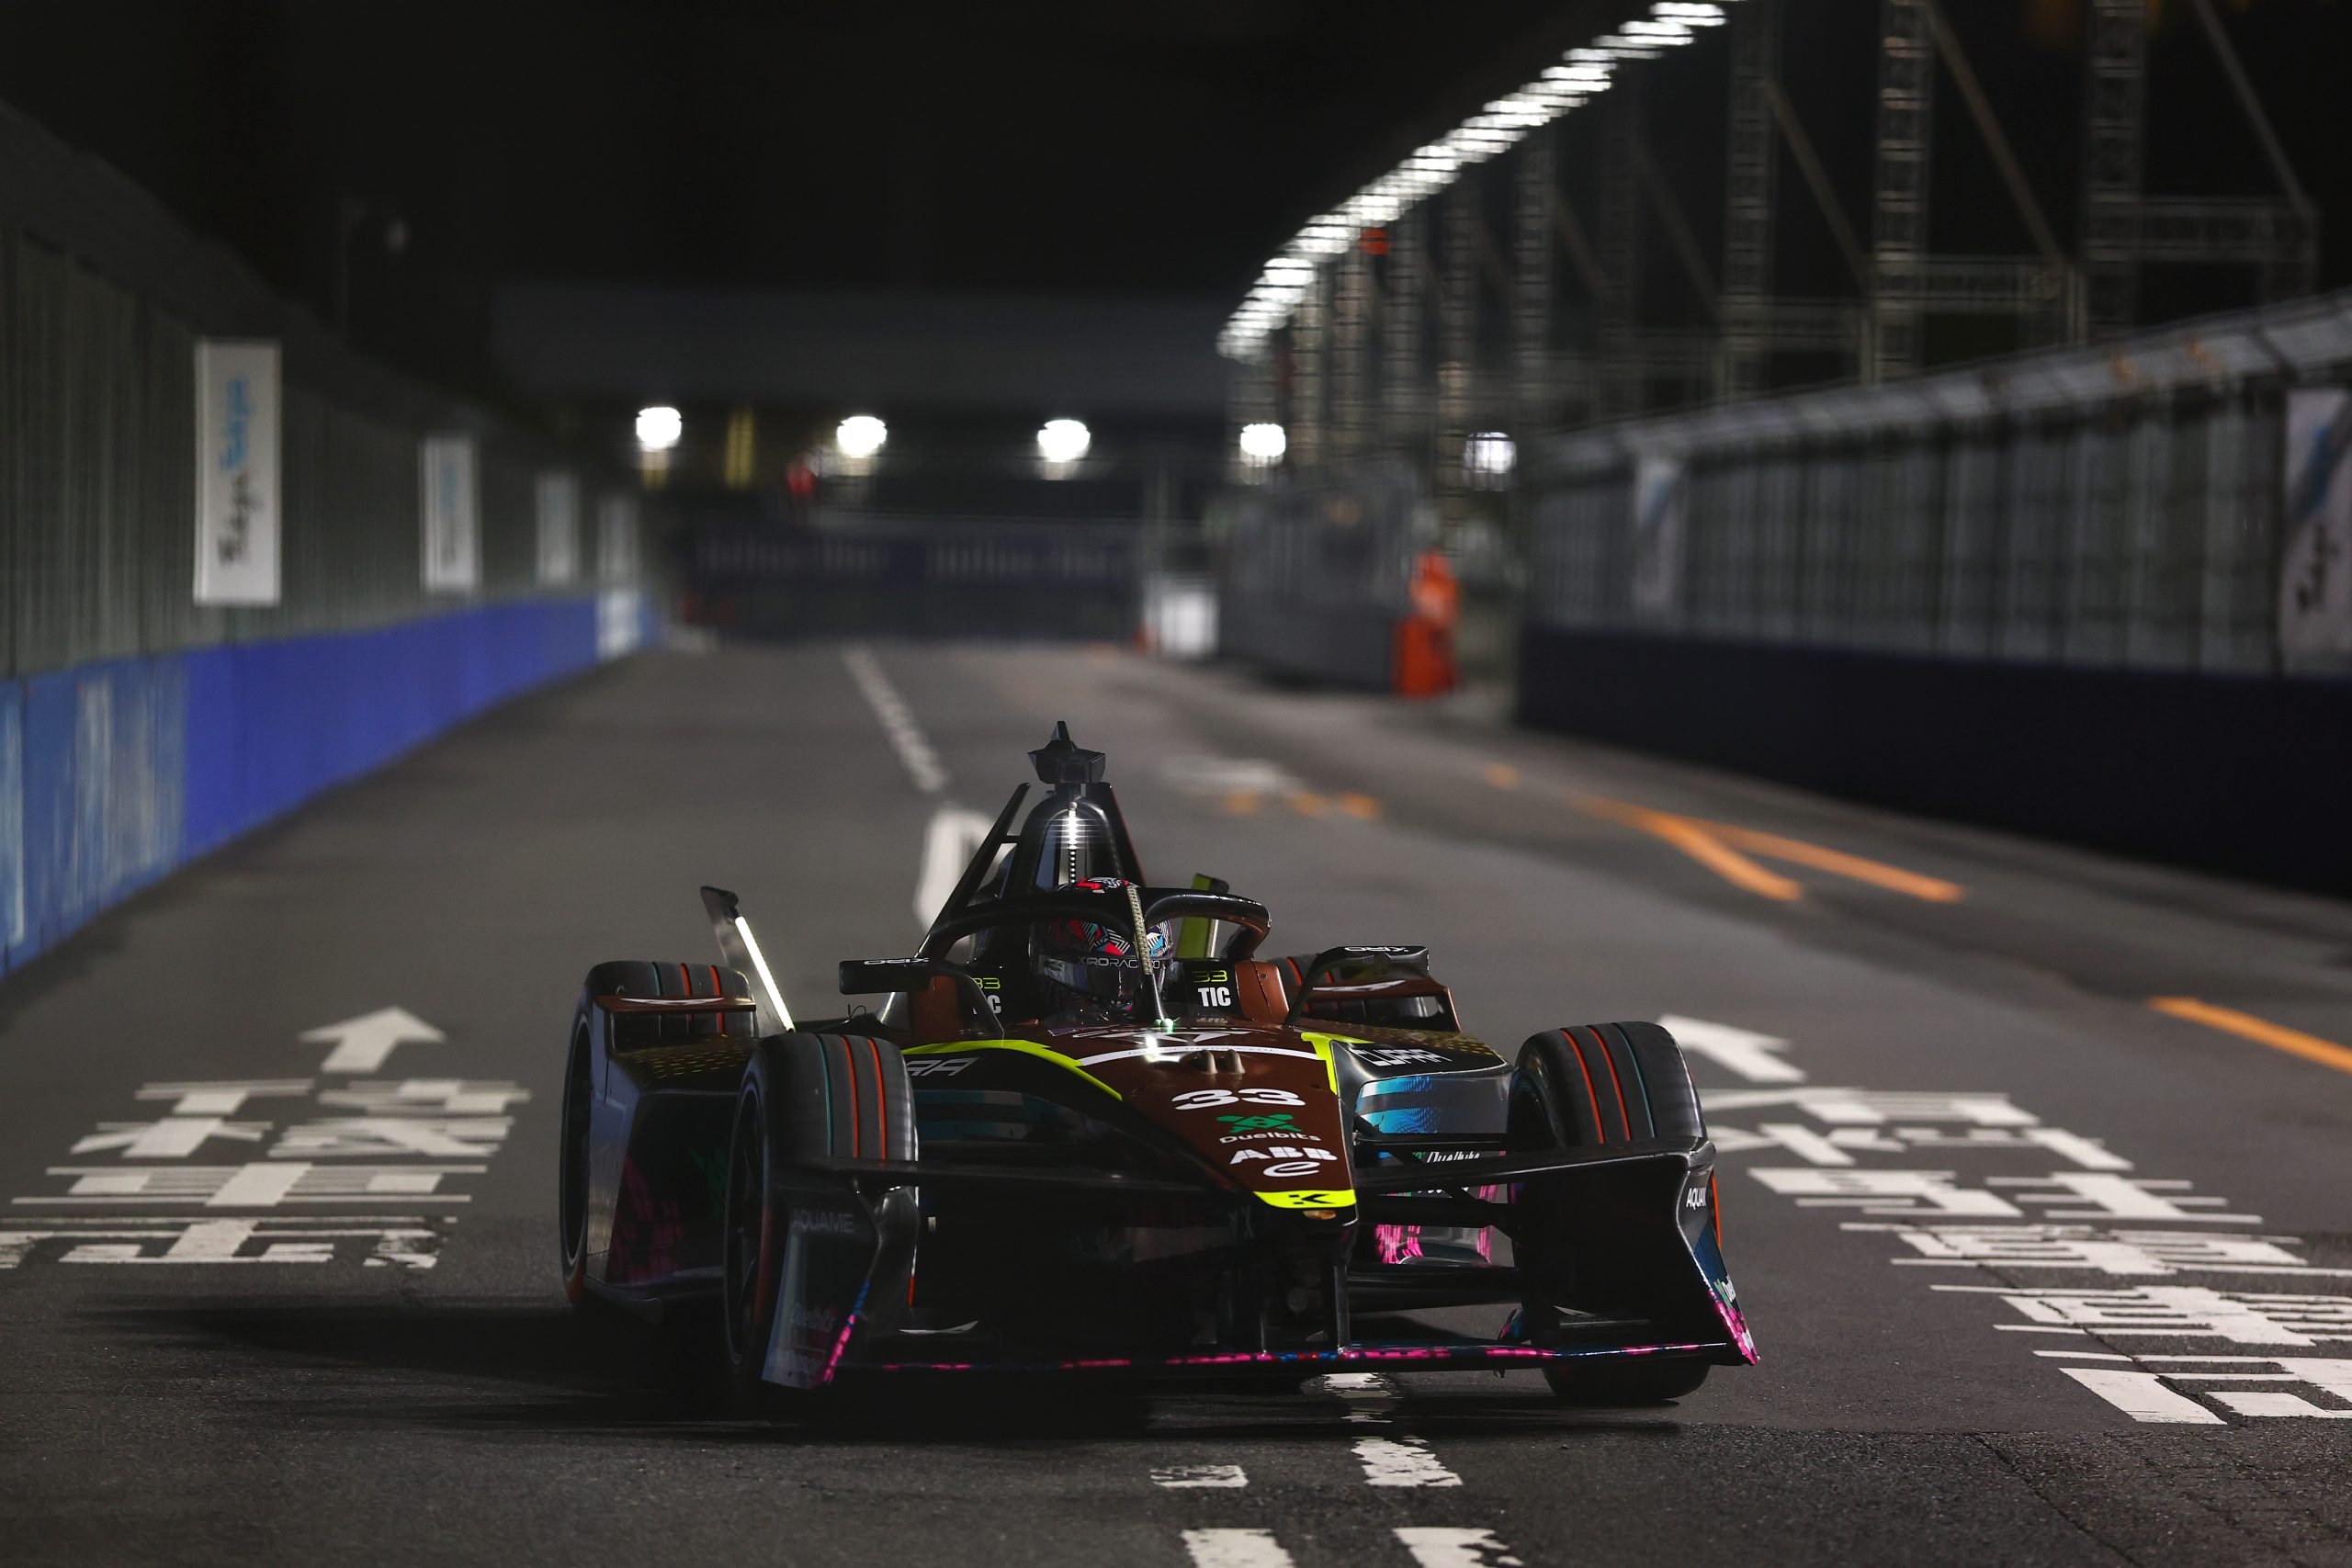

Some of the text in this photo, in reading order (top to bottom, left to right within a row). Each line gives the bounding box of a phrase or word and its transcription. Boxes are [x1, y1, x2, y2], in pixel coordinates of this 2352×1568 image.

[1197, 986, 1232, 1008] TIC
[1171, 1088, 1306, 1111] 33
[1218, 1131, 1322, 1145] Duelbits
[1229, 1145, 1339, 1165] ABB
